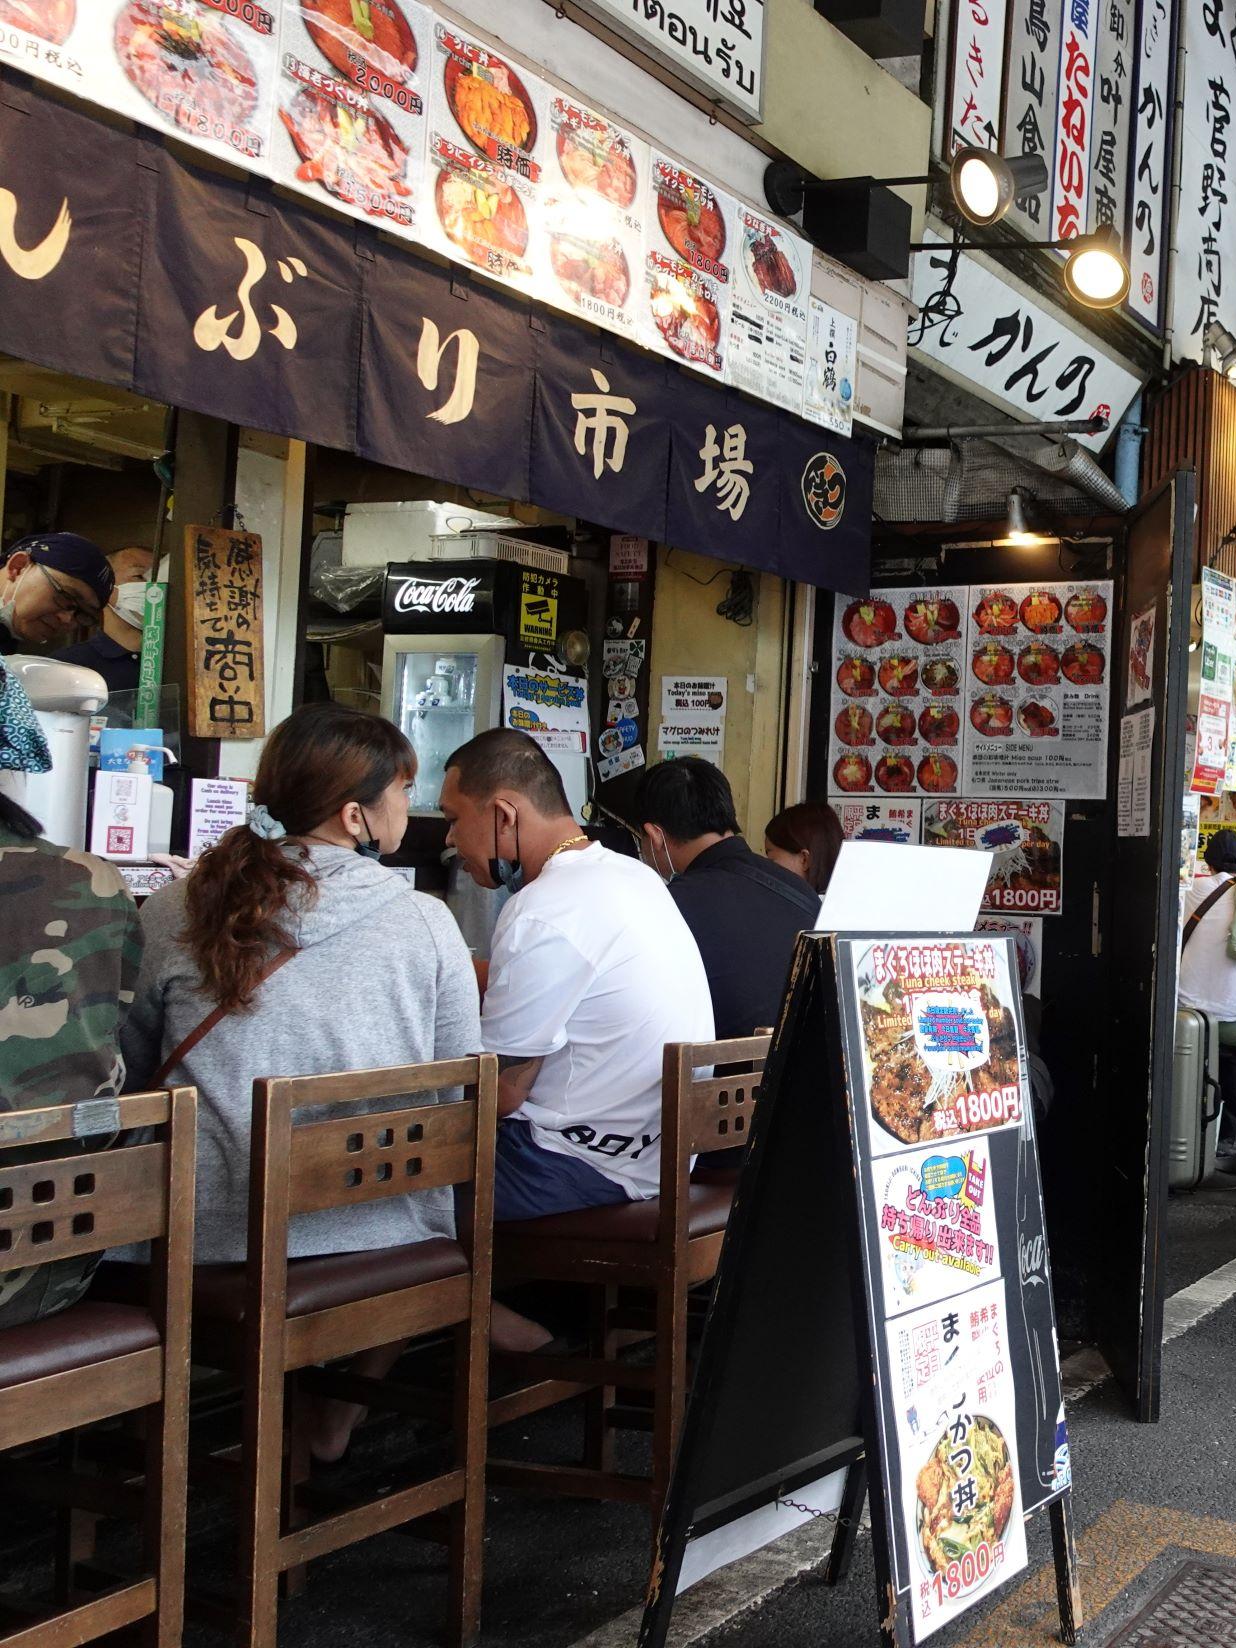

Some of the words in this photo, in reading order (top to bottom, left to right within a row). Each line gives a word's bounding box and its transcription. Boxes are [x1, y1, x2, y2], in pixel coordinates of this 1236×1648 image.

[354, 67, 424, 117] 2000円
[1137, 81, 1164, 257] かんの
[967, 307, 1096, 417] かんの
[394, 577, 482, 613] Coca-Cola
[523, 623, 553, 638] WARNING
[1019, 744, 1034, 752] MENU
[938, 801, 1050, 824] まぐろほほ肉ステーキ丼
[958, 819, 977, 827] Tuna
[936, 837, 965, 847] Limited
[1021, 841, 1034, 849] per
[1036, 841, 1051, 850] day
[991, 889, 1058, 908] 1800円
[873, 946, 998, 984] まぐろほほ肉ステーキ丼
[900, 975, 923, 989] Tuna
[924, 975, 949, 988] cheek
[951, 974, 977, 987] steak
[877, 1013, 913, 1029] Limited
[989, 1006, 1003, 1020] day
[956, 1085, 1020, 1126] 1800円
[968, 1172, 984, 1189] TAKE
[968, 1185, 982, 1199] OUT
[905, 1184, 981, 1236] どんぶり全品
[881, 1203, 994, 1265] 持ち帰り出来ます!!
[892, 1235, 921, 1261] Carry
[922, 1245, 941, 1261] out
[942, 1252, 982, 1277] available
[931, 1541, 1006, 1608] 1800円
